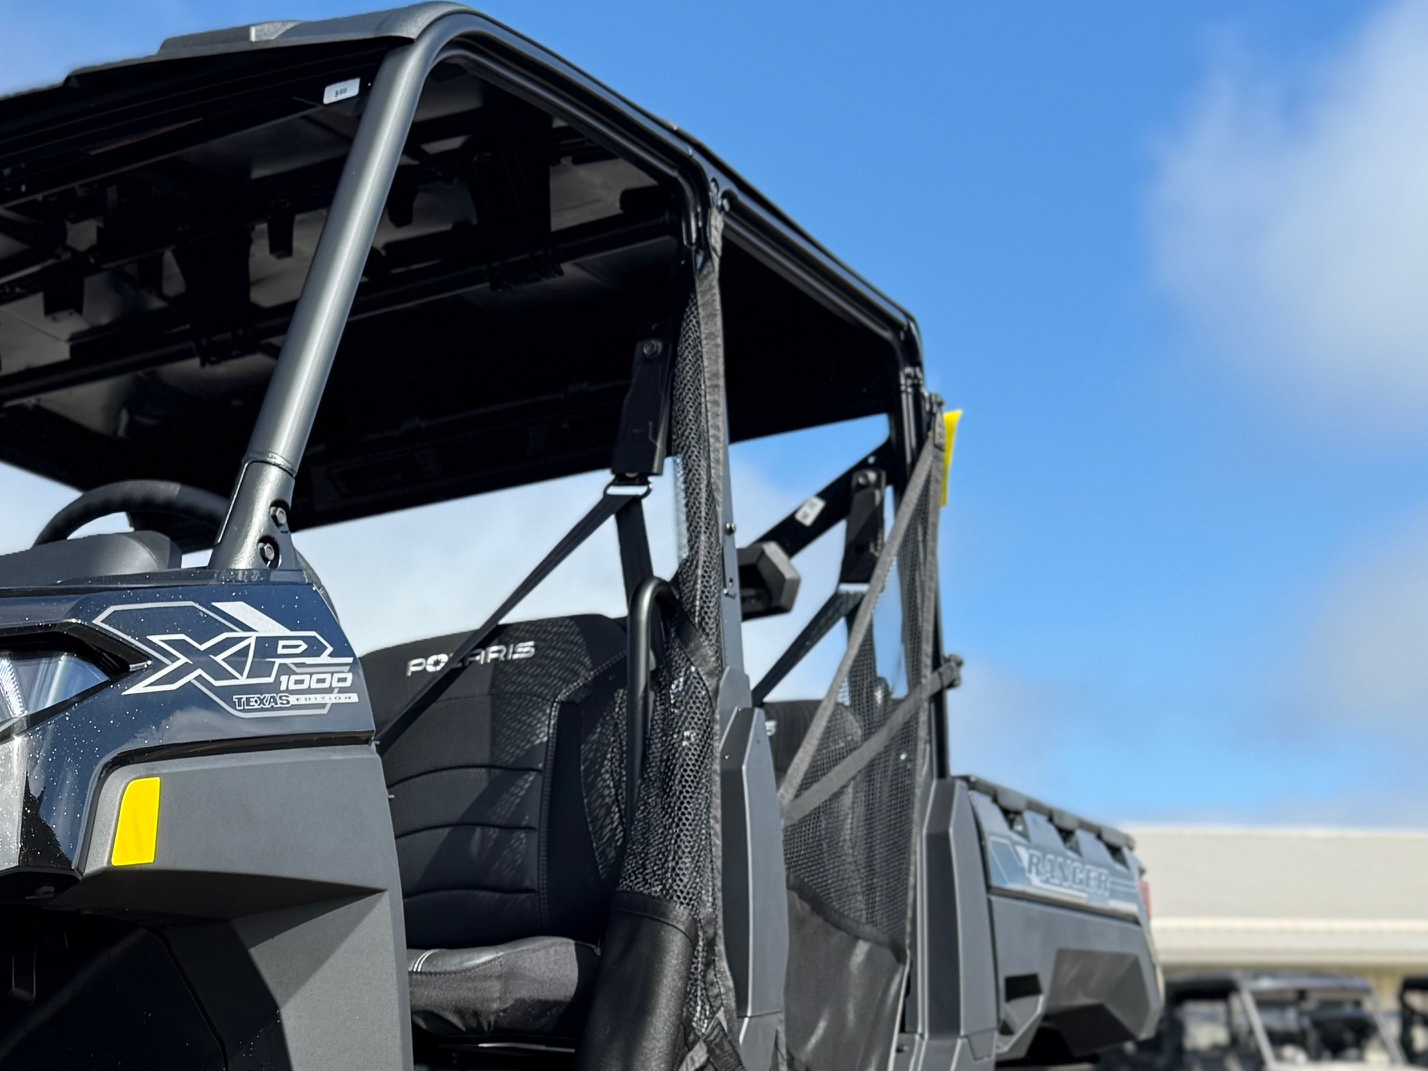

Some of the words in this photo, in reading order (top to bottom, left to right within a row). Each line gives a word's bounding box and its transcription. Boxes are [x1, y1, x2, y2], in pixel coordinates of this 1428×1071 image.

[279, 672, 353, 691] 1000
[232, 693, 292, 710] TEXAS
[1027, 849, 1111, 897] RANGER
